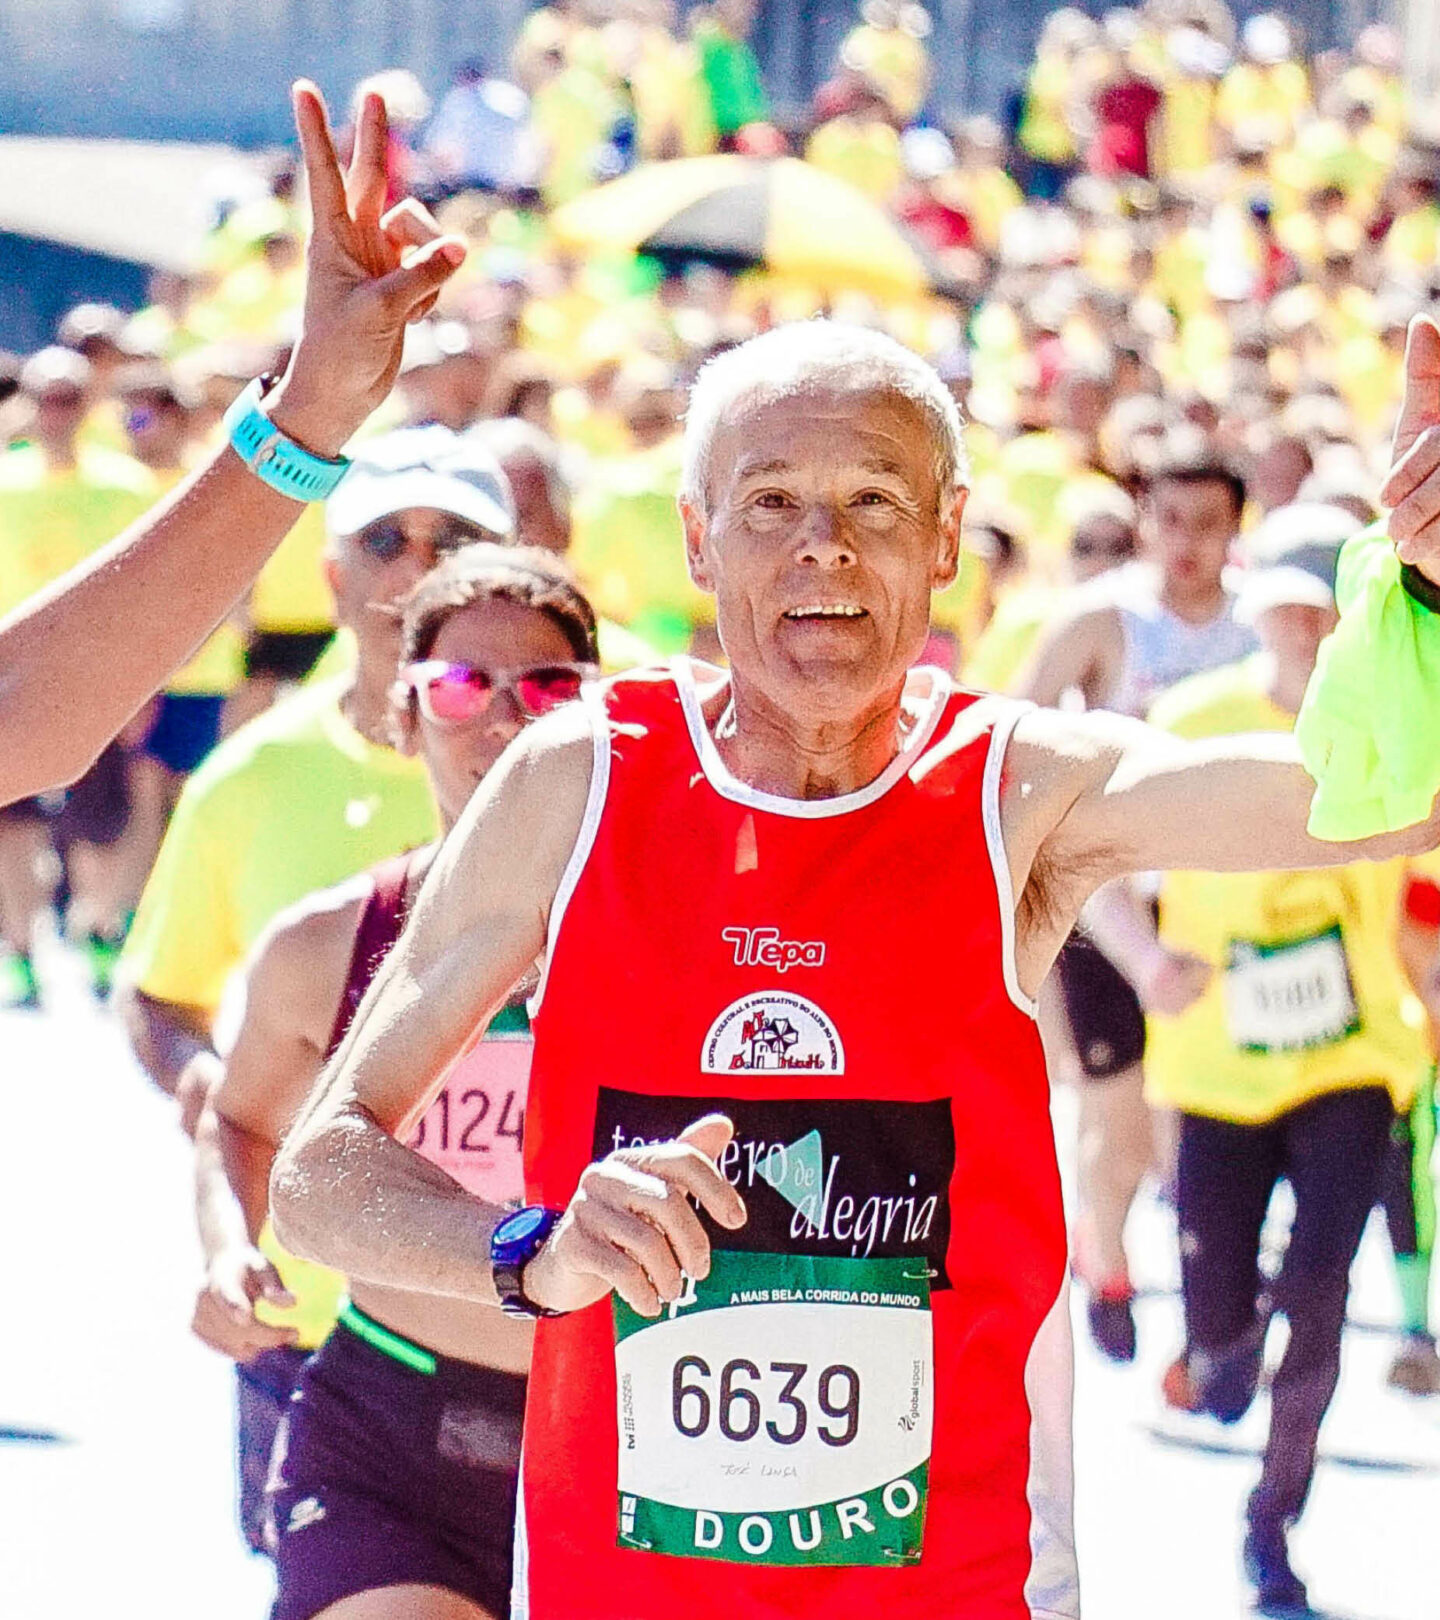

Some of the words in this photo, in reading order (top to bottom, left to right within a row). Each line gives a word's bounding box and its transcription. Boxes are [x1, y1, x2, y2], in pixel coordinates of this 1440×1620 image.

[411, 1089, 523, 1153] 124
[790, 1155, 938, 1258] alegria
[795, 1158, 814, 1187] de
[730, 1293, 740, 1304] A
[741, 1291, 770, 1303] MAIS
[771, 1289, 803, 1301] BELA
[805, 1289, 859, 1303] CORRIDA
[860, 1292, 878, 1304] DO
[880, 1293, 920, 1307] MUNDO
[672, 1355, 860, 1448] 6639
[694, 1478, 918, 1555] DOURO
